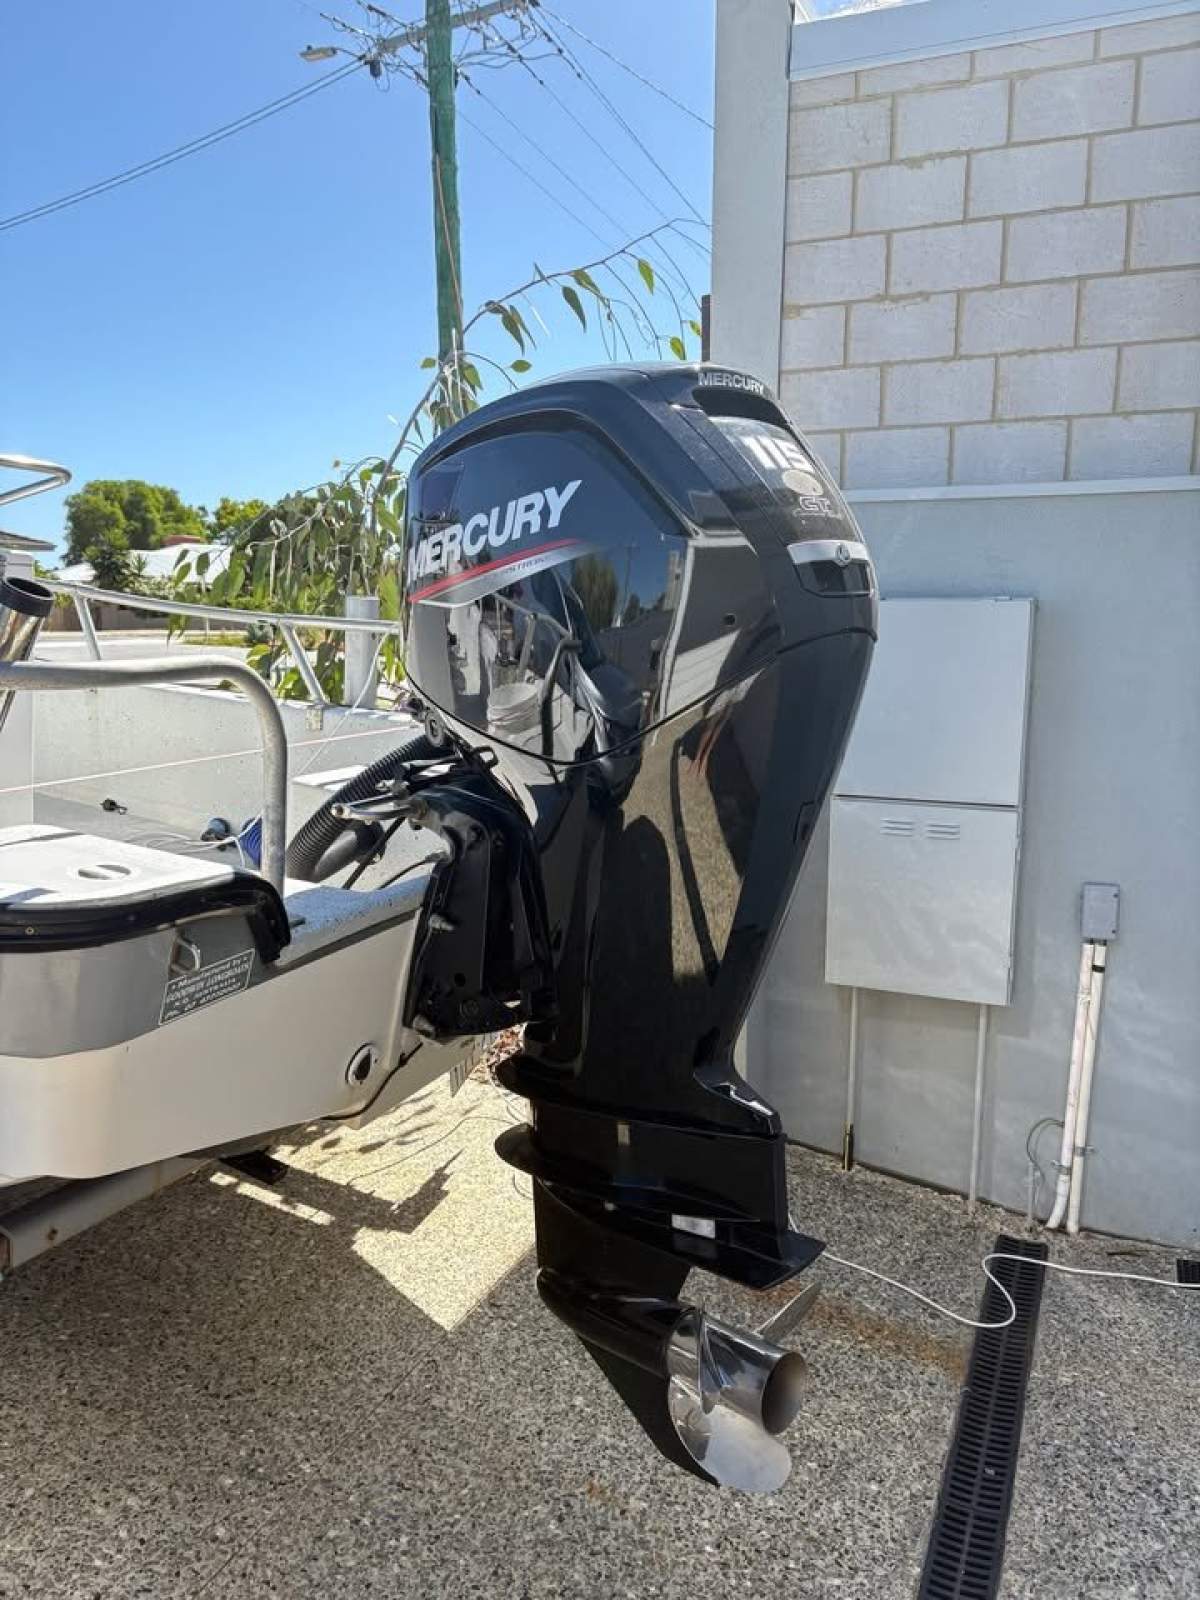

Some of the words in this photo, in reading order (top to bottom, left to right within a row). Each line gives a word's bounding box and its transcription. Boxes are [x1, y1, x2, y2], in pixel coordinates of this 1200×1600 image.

[698, 372, 764, 395] MERCURY
[740, 436, 815, 473] 115
[407, 480, 582, 586] MERCURY
